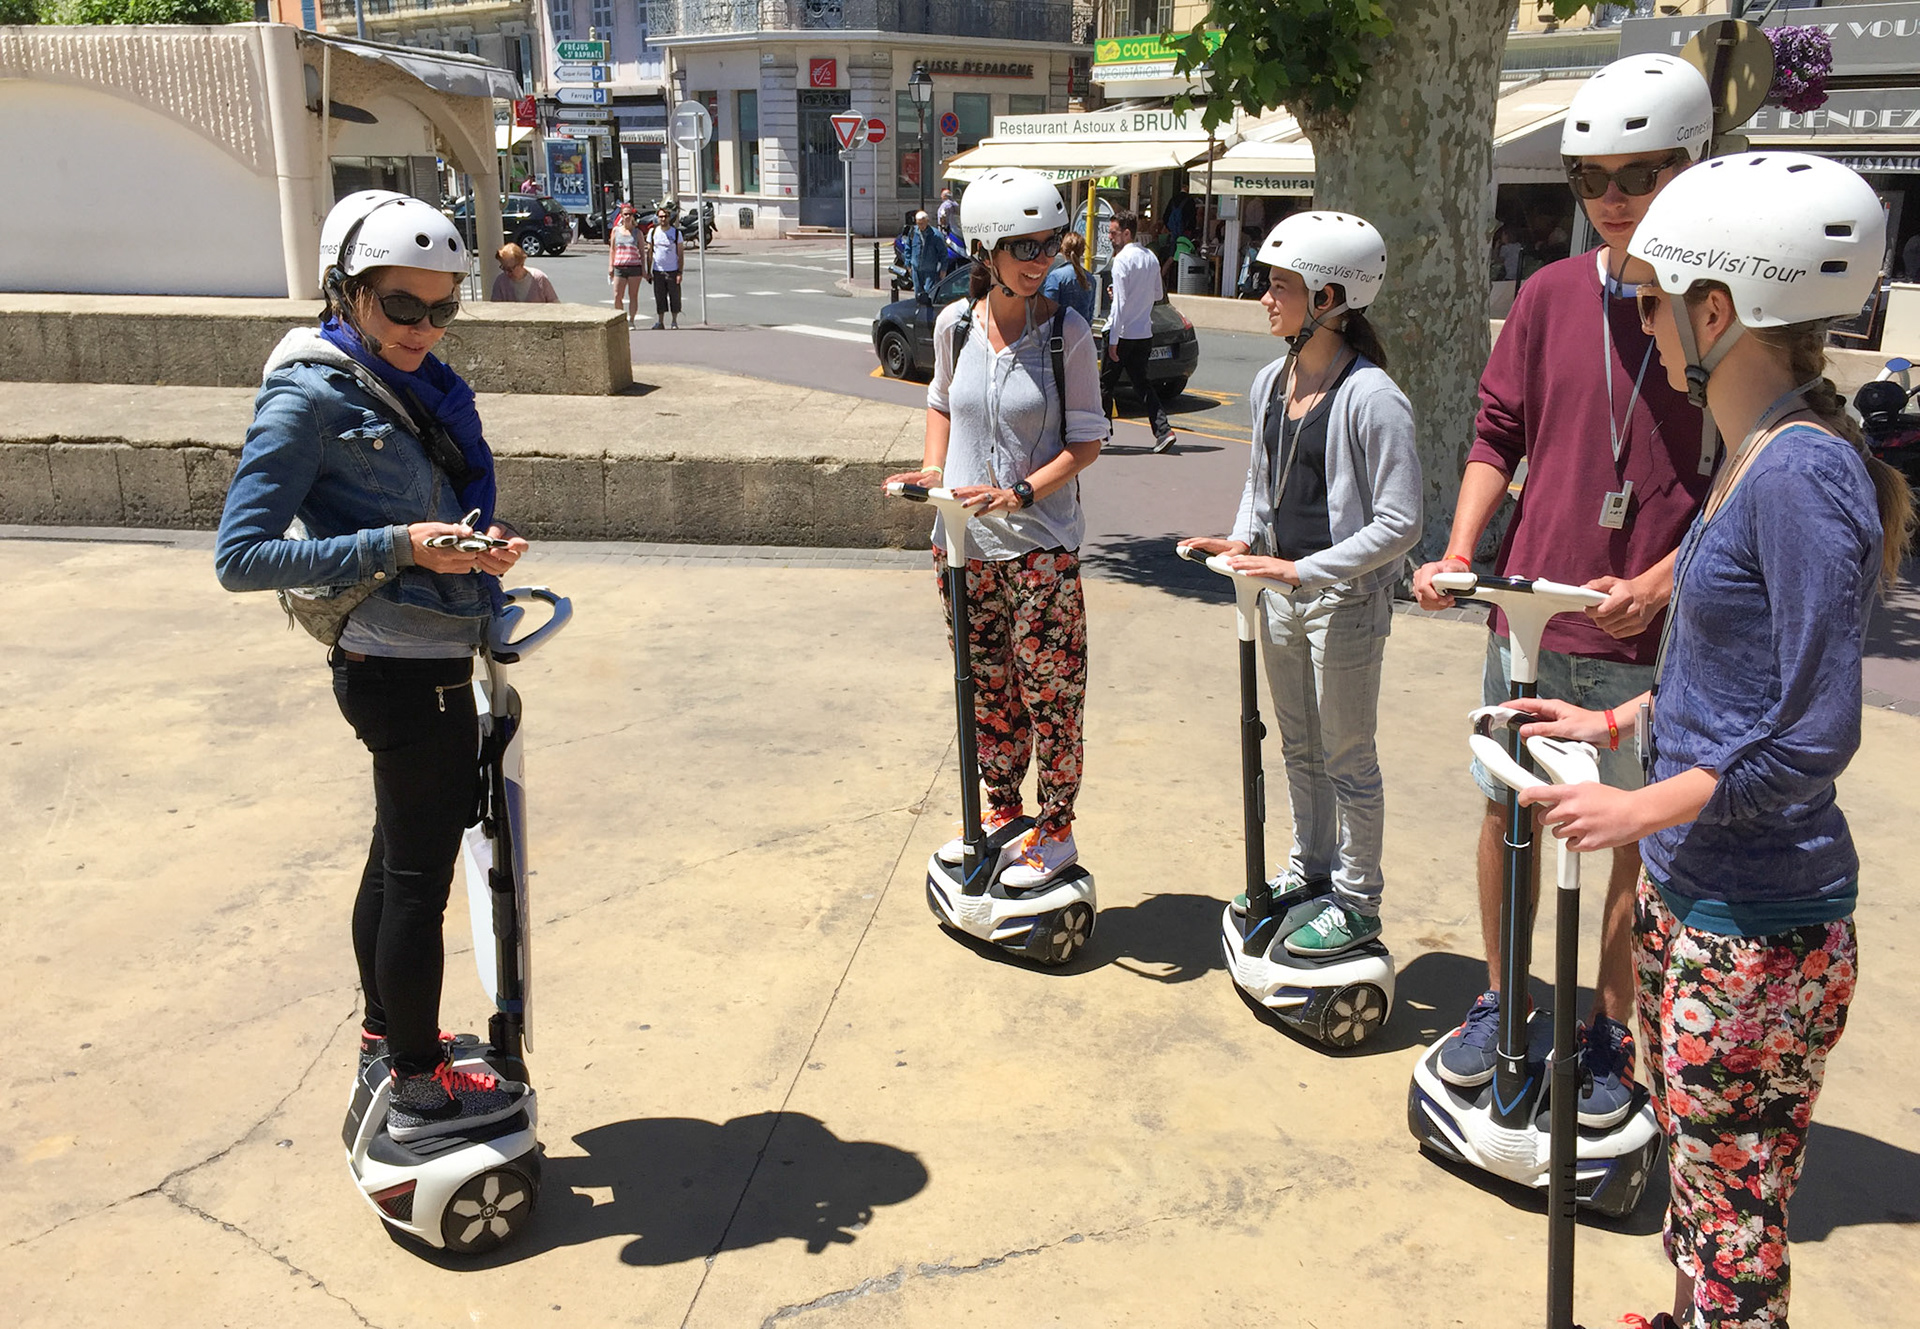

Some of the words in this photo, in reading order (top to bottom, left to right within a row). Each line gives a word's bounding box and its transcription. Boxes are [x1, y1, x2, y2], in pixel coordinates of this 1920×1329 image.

[1846, 19, 1920, 39] VOU
[563, 43, 589, 51] FRÉJUS
[913, 59, 958, 73] CAISSE
[963, 60, 1034, 76] D'EPARGNE
[1000, 121, 1068, 135] Restaurant
[1073, 119, 1115, 133] Astoux
[1120, 119, 1128, 132] &
[1133, 112, 1187, 132] BRUN
